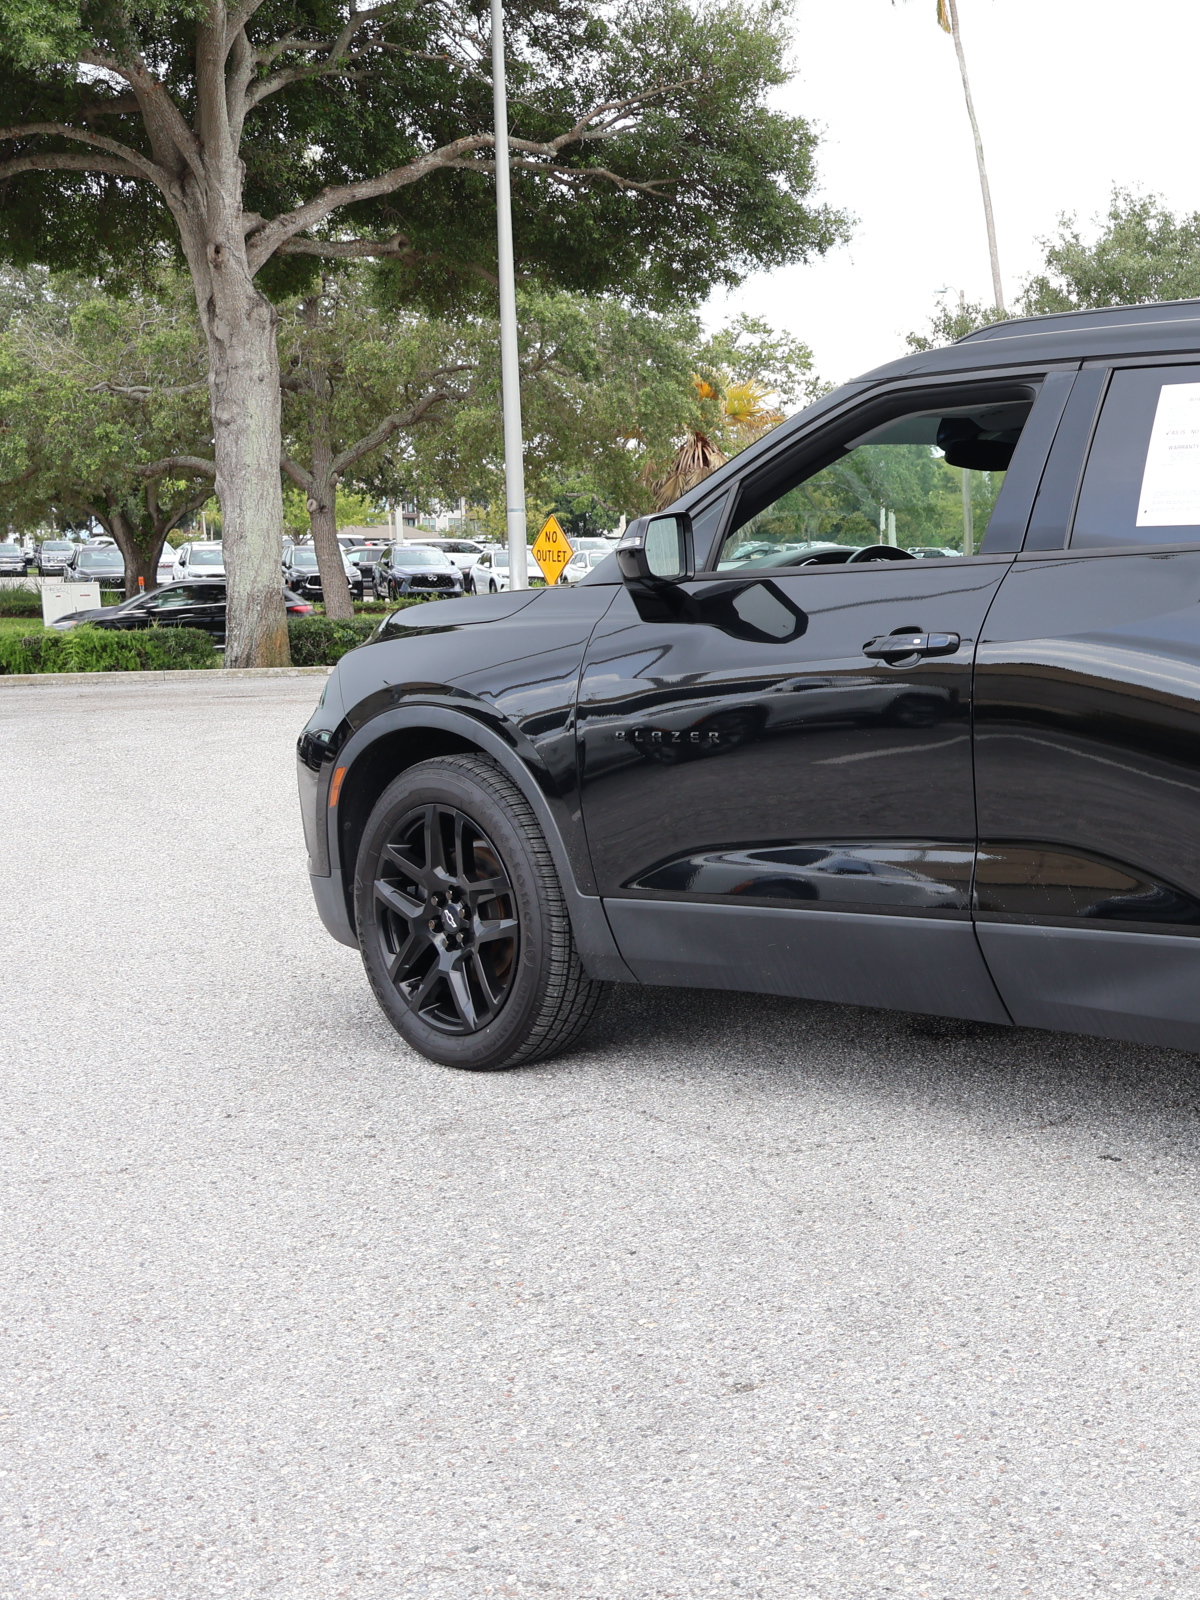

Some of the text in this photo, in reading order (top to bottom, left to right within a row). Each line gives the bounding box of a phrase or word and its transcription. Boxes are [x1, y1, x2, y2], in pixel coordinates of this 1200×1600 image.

[545, 531, 557, 543] NO
[536, 549, 567, 562] OUTLET
[615, 730, 720, 743] BLAZER
